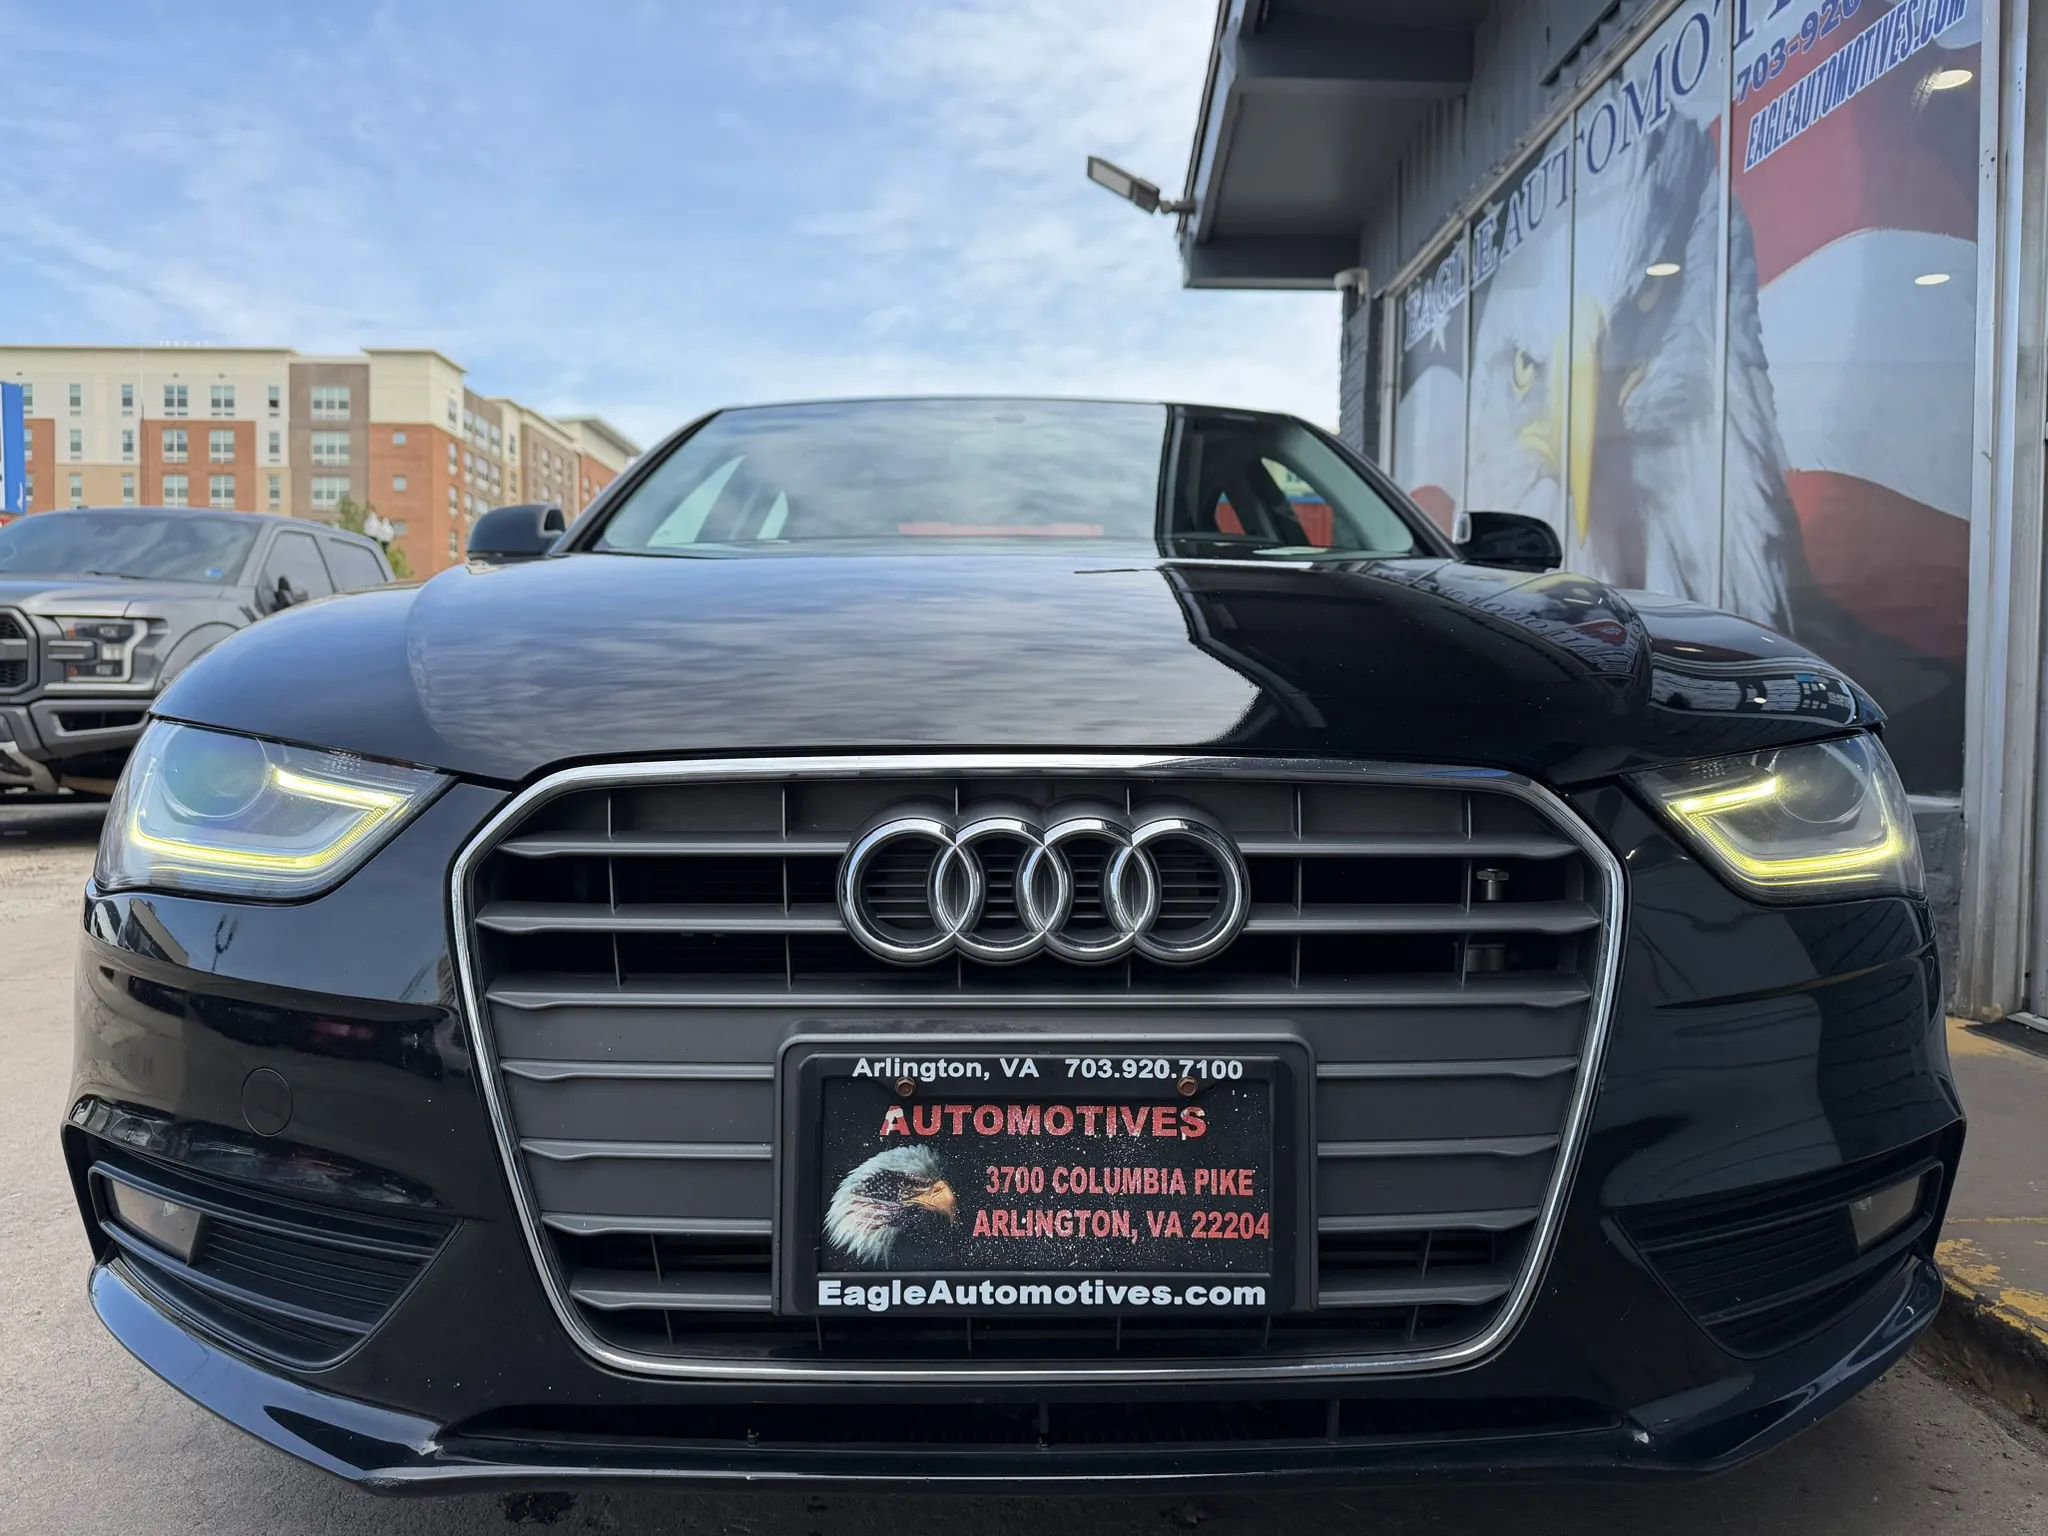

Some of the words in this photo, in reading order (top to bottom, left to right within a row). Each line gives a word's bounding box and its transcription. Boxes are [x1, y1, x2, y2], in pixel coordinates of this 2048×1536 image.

[1500, 0, 1791, 263] AUTOMOT
[852, 1058, 991, 1082] Arlington,
[1000, 1058, 1040, 1078] VA
[1065, 1058, 1243, 1080] 703.920.7100
[879, 1104, 1207, 1139] AUTOMOTIVES
[985, 1166, 1045, 1194] 3700
[1052, 1166, 1187, 1196] COLUMBIA
[1194, 1168, 1254, 1197] PIKE
[972, 1208, 1138, 1244] ARLINGTON,
[1147, 1210, 1184, 1238] VA
[1191, 1211, 1270, 1240] 22204
[817, 1279, 1266, 1312] EagleAutomotives.com
